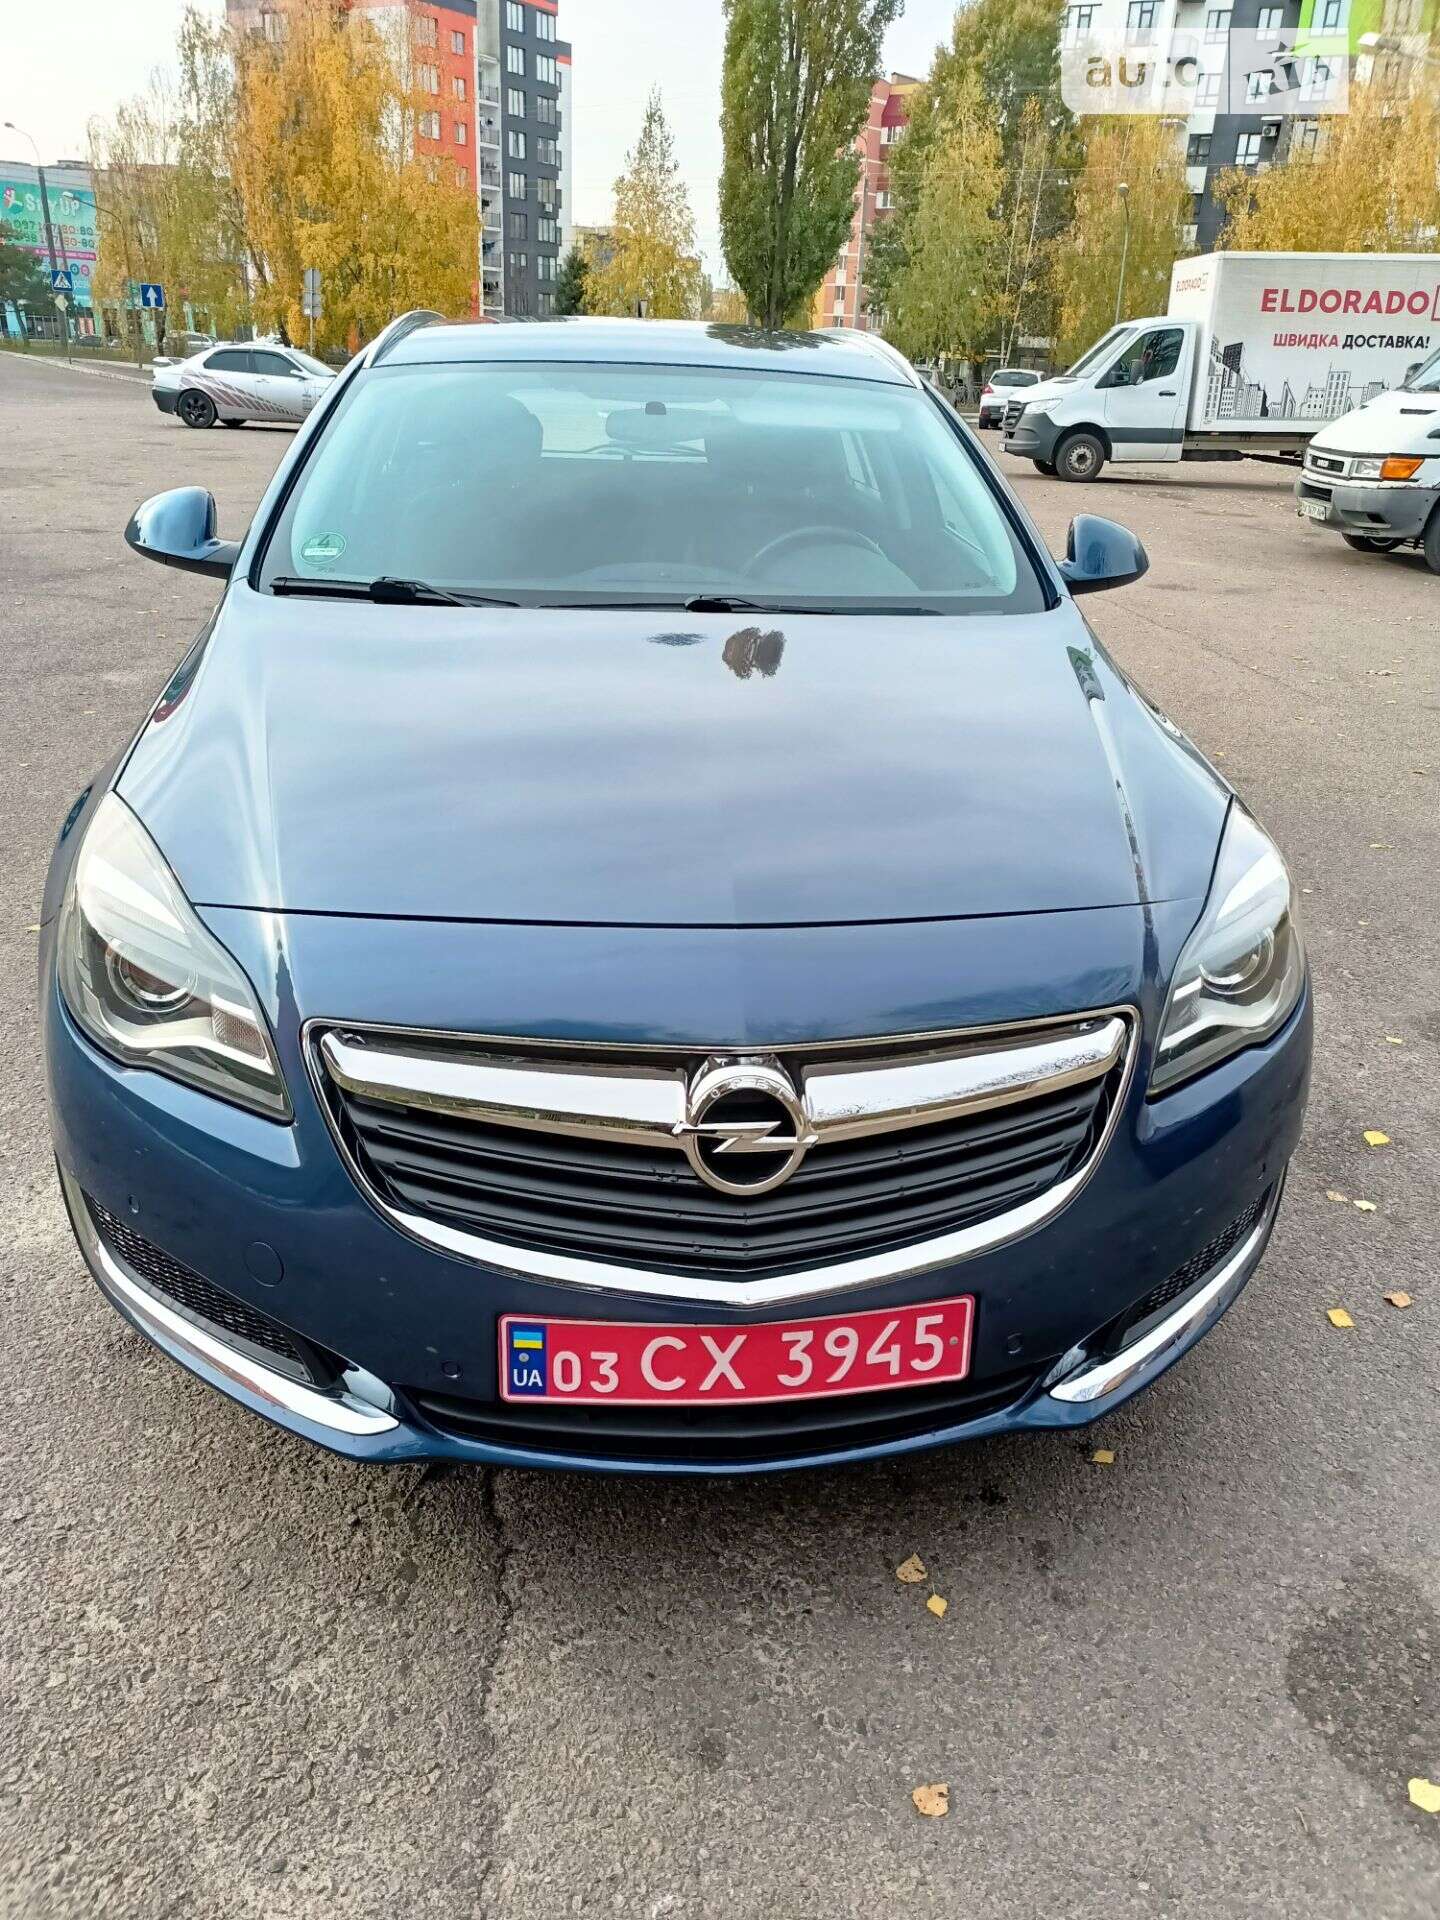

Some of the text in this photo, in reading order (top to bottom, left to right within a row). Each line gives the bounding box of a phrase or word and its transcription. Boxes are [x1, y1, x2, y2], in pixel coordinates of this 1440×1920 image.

[1261, 288, 1430, 315] ELDORADO
[1273, 333, 1430, 350] ШВИДКА ДОСТАВКА!
[317, 534, 330, 548] 4
[552, 1314, 944, 1393] 03 CX 3945
[513, 1369, 543, 1387] UA
